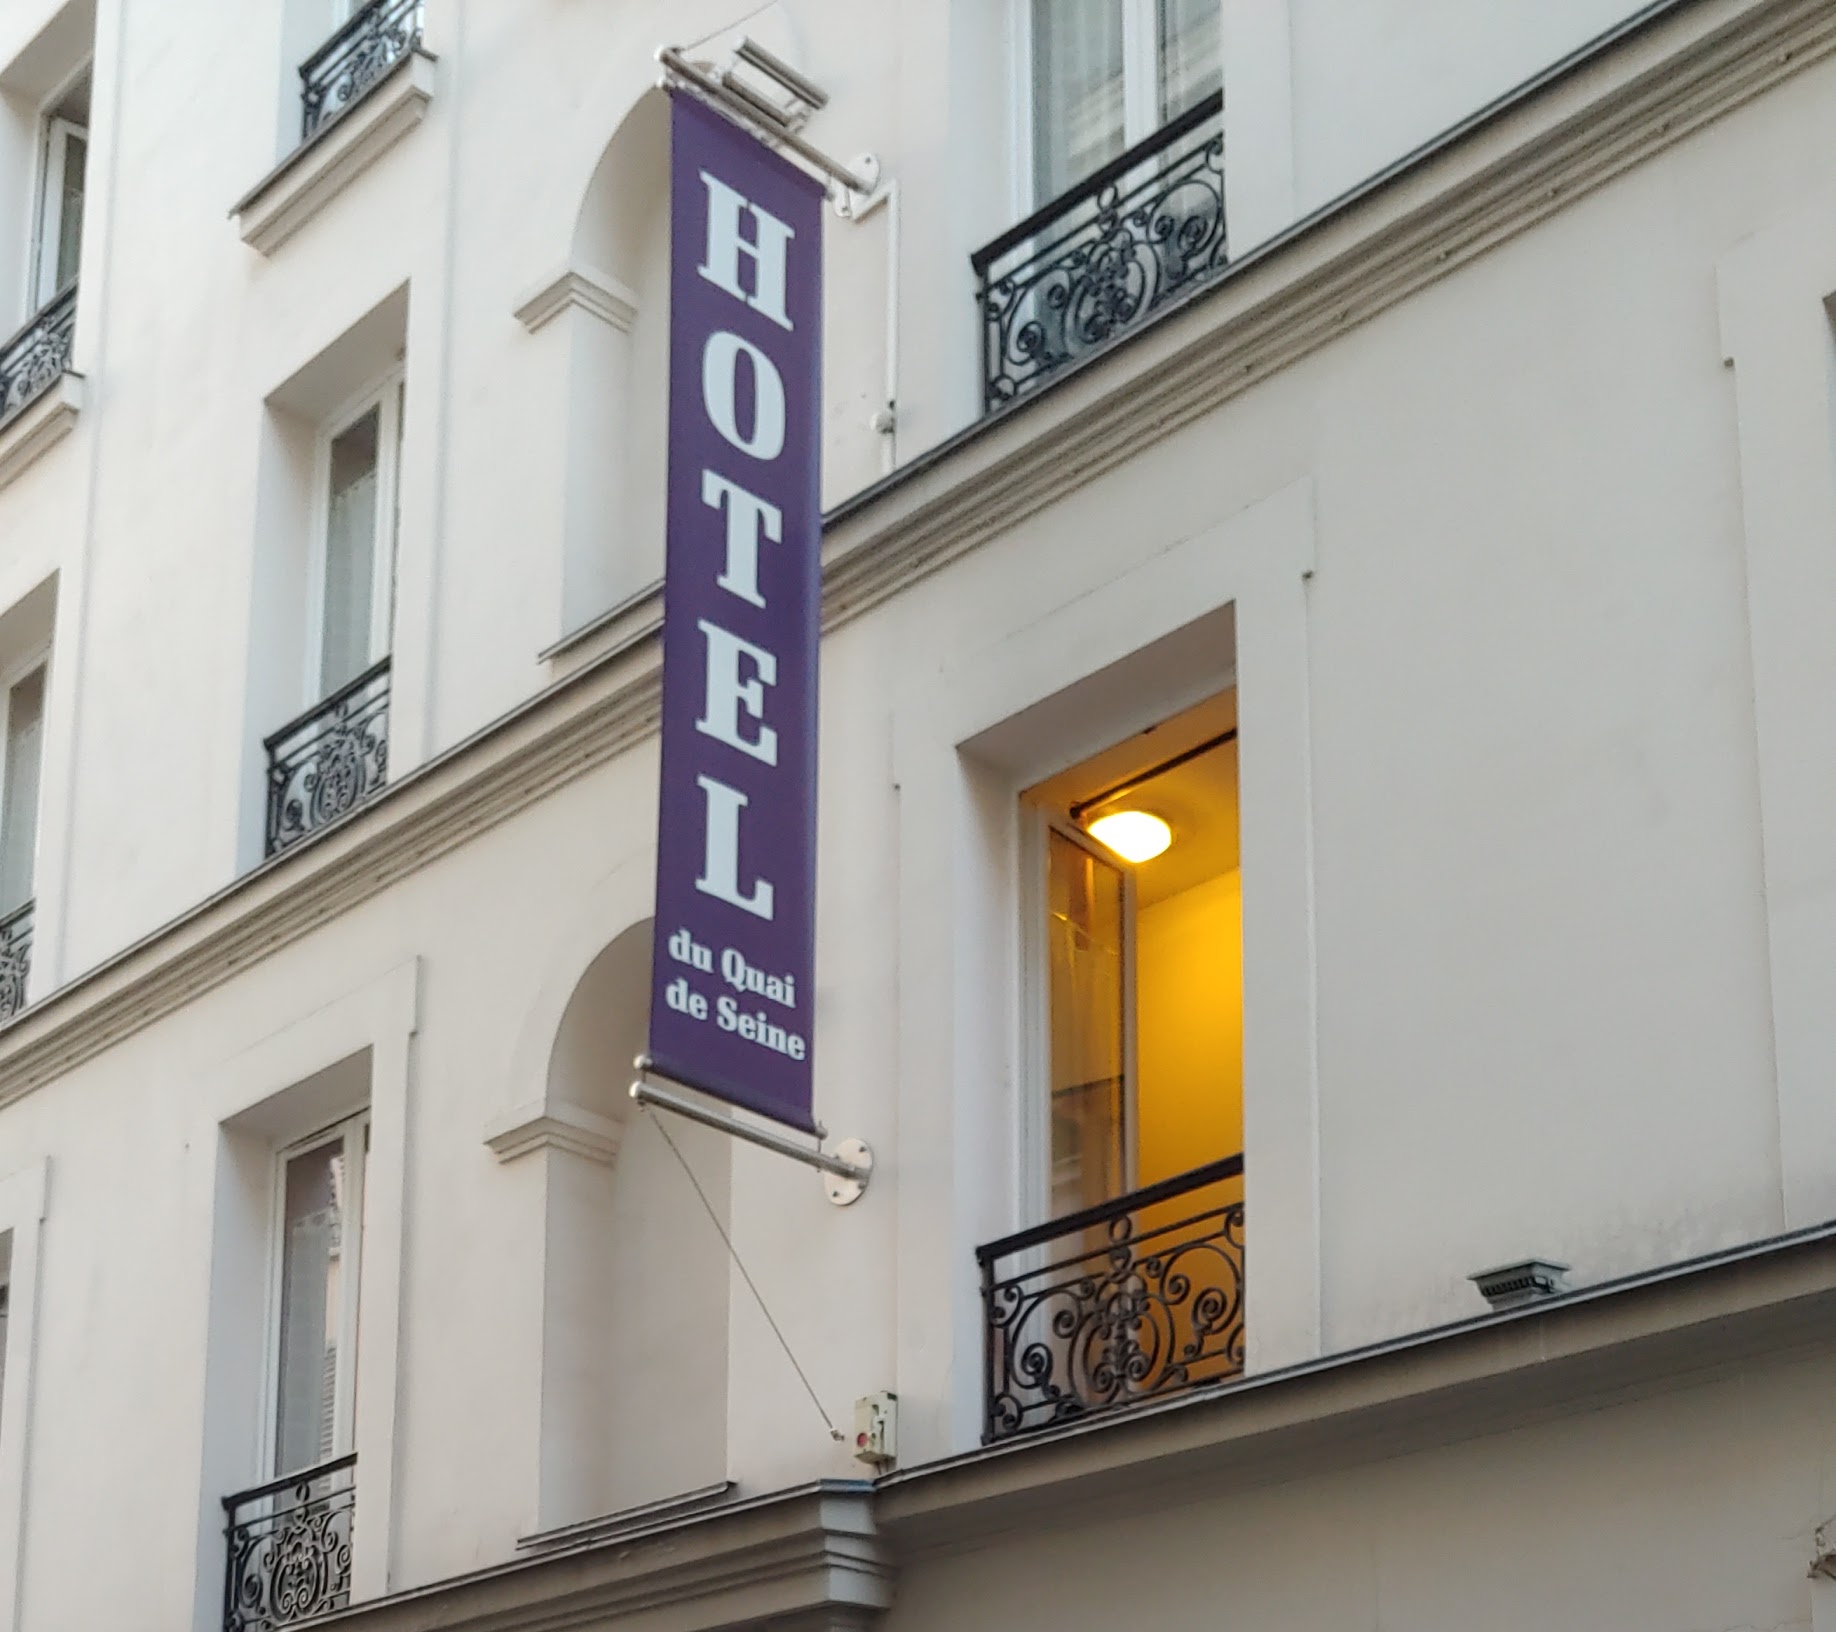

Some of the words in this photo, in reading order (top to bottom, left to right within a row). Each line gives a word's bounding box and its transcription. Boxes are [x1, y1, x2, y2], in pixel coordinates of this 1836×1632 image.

[695, 170, 796, 921] HOTEL
[668, 928, 714, 974] du
[721, 947, 796, 1009] Quai
[665, 977, 709, 1021] de
[716, 995, 806, 1061] Seine
